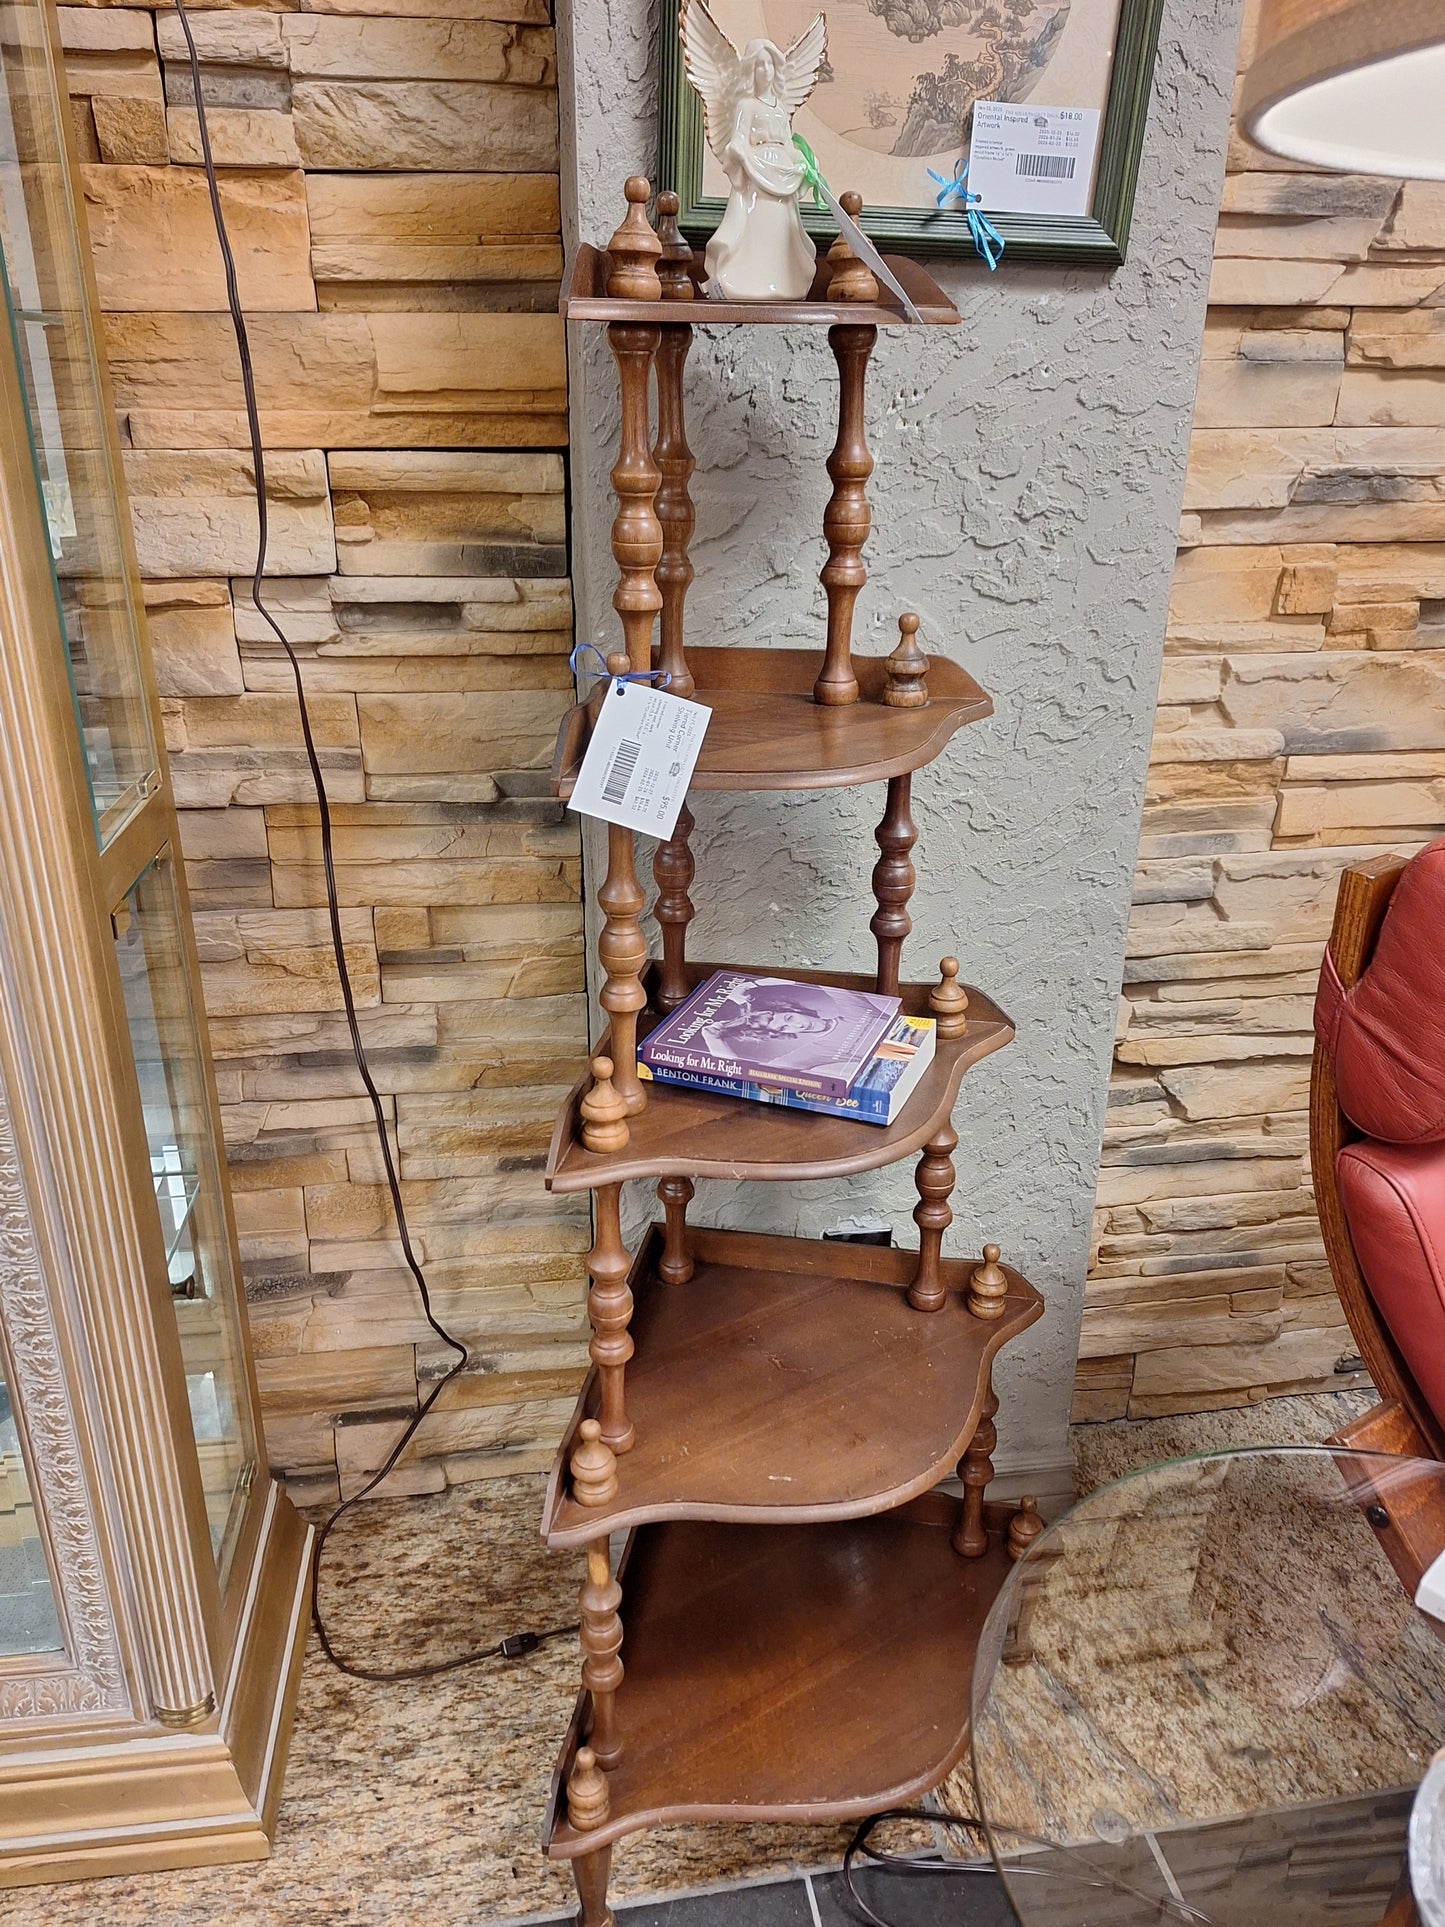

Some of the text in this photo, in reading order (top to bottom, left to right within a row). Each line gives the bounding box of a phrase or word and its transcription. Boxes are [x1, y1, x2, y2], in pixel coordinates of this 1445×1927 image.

[977, 120, 1000, 128] Artwork
[978, 112, 1003, 120] Oriental
[1004, 115, 1028, 123] Inspired
[1060, 111, 1082, 120] $18.00
[668, 704, 685, 734] Shelving
[680, 708, 692, 729] Tiered
[664, 733, 675, 748] Unit
[672, 729, 685, 752] Corner
[655, 795, 670, 820] $95.00
[667, 1016, 714, 1044] Looking
[694, 1006, 717, 1018] for
[716, 976, 746, 1000] Right
[650, 1048, 742, 1077] Looking for Mr. Right
[657, 1068, 737, 1090] BENTON FRANK
